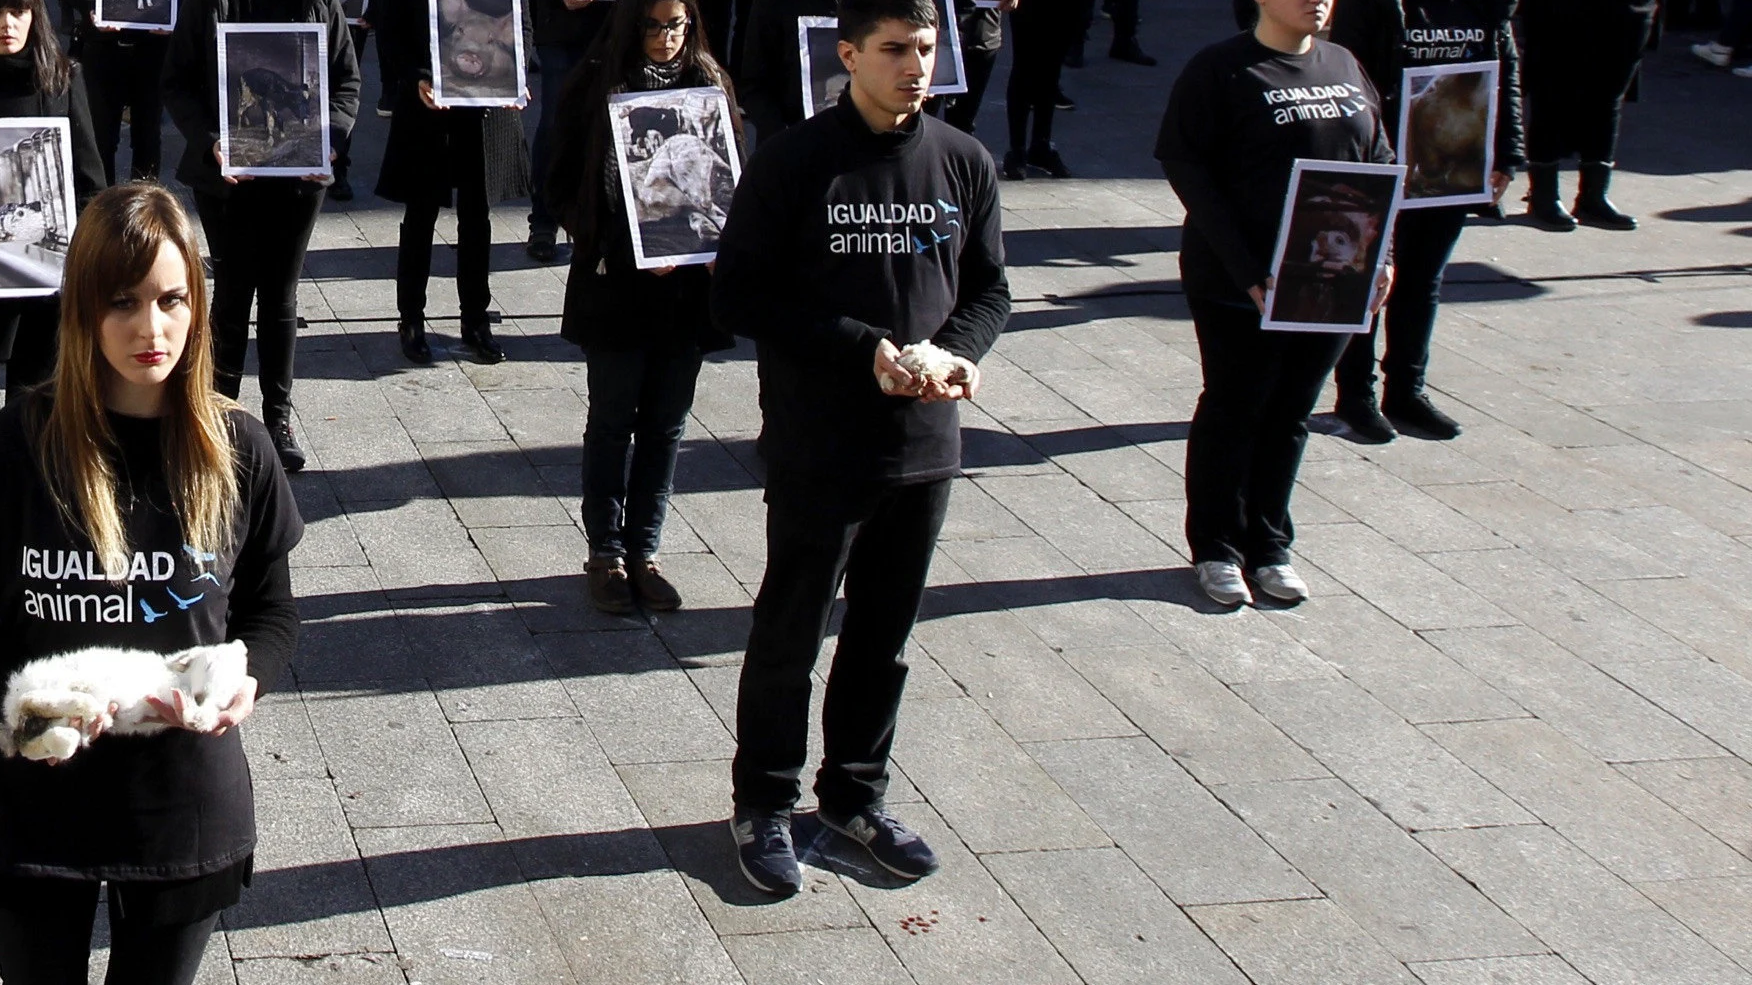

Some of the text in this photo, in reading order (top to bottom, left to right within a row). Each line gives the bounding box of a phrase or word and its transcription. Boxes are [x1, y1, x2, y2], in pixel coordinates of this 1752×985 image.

[1405, 28, 1485, 43] IGUALDAD
[1408, 42, 1466, 60] animal
[1263, 82, 1349, 106] IGUALDAD
[1273, 98, 1341, 125] animal
[827, 203, 936, 225] IGUALDAD
[830, 226, 911, 254] animal
[21, 545, 175, 581] IGUALDAD
[24, 583, 133, 623] animal
